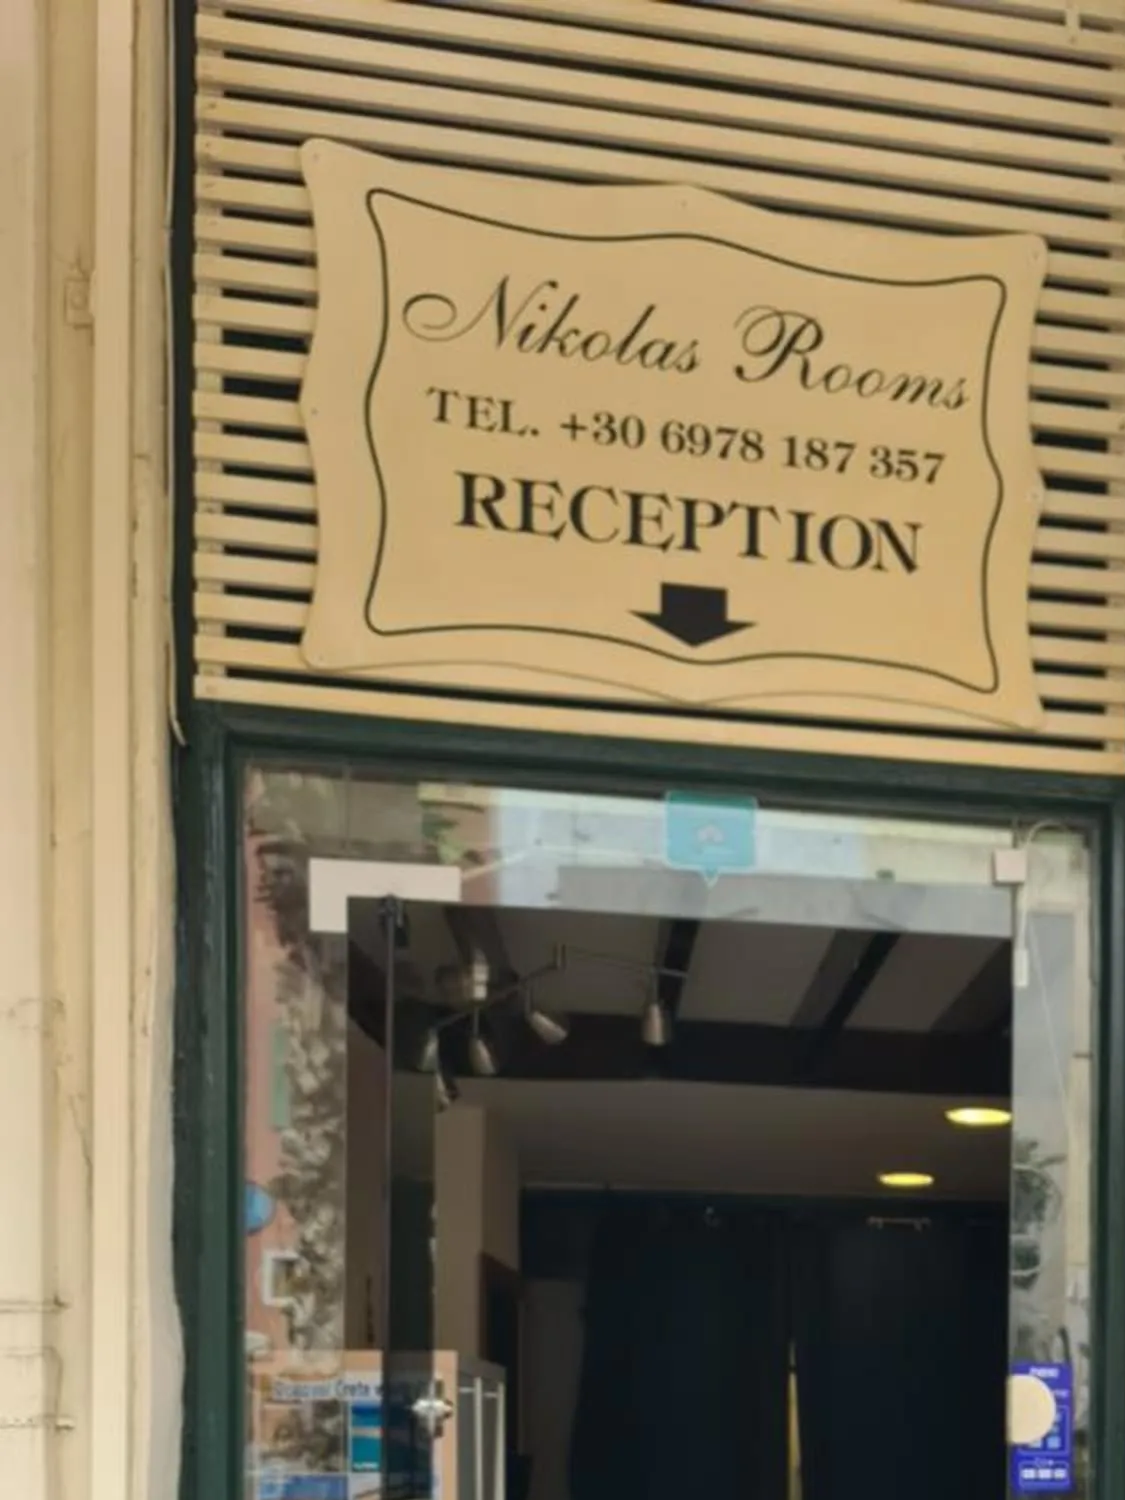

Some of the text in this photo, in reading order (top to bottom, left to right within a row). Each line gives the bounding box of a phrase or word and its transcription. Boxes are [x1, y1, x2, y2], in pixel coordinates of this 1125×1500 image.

[403, 275, 969, 411] Nikolas Rooms
[426, 386, 945, 485] TEL. +30 6978 187 357
[455, 471, 922, 574] RECEPTION
